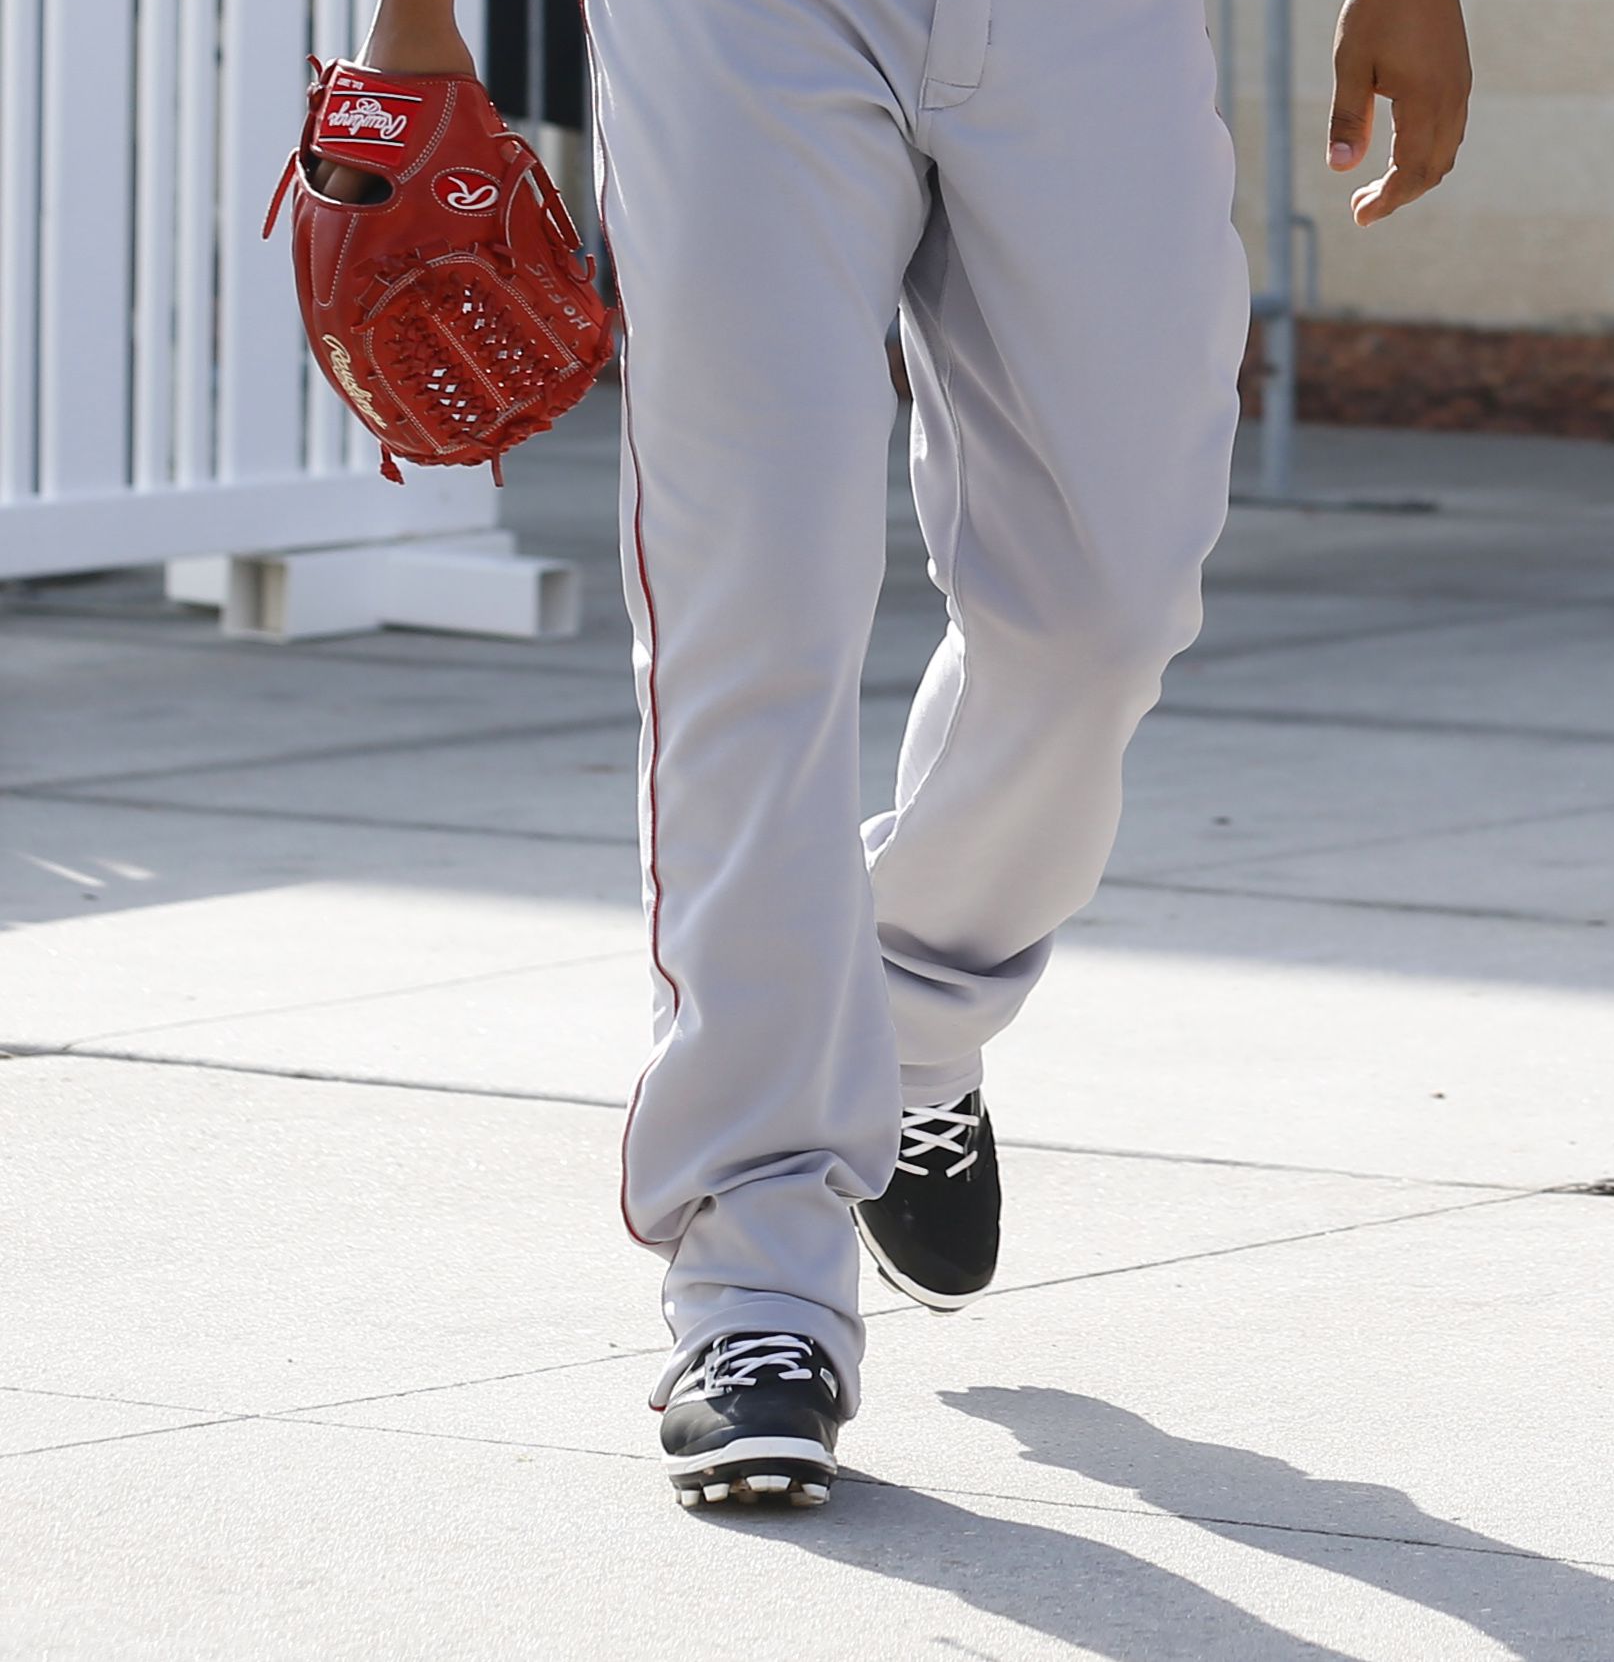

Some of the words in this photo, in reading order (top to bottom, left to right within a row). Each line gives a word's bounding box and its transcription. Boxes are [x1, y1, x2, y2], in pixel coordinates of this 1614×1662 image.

[327, 100, 408, 140] Rawlings
[446, 176, 498, 211] R
[322, 333, 388, 430] Rawlings
